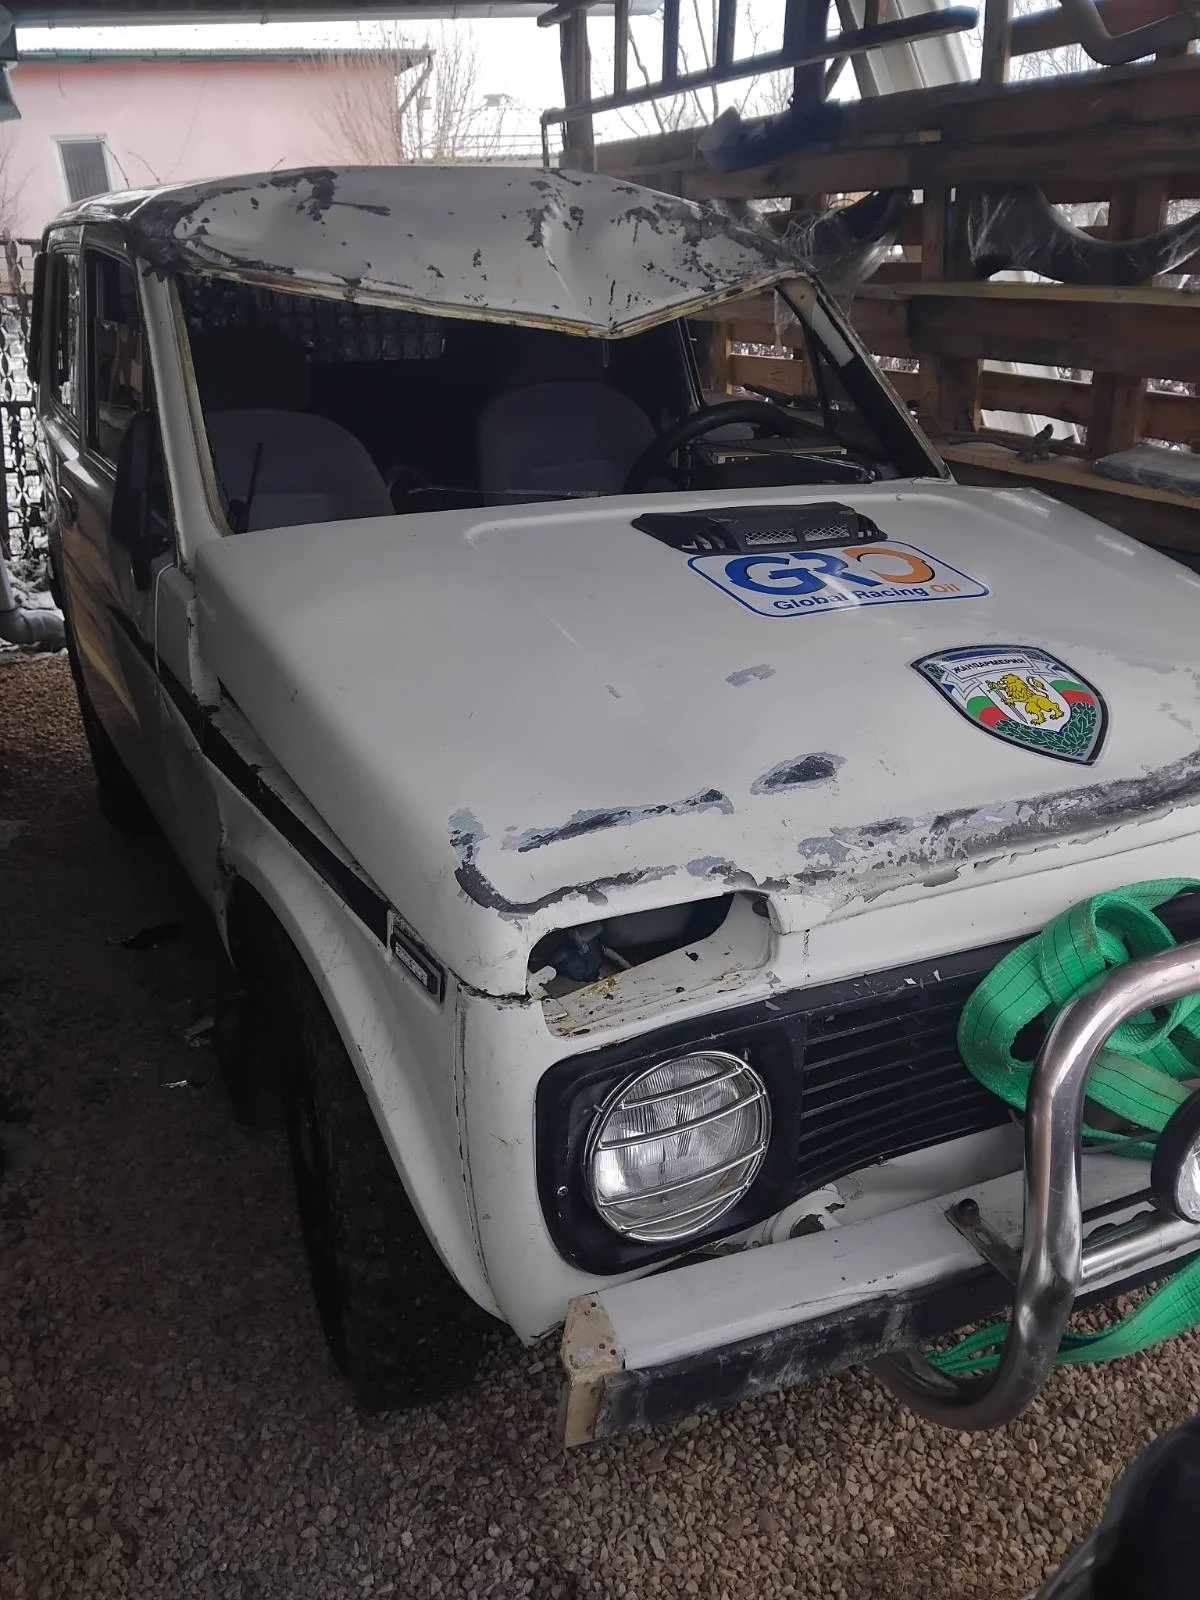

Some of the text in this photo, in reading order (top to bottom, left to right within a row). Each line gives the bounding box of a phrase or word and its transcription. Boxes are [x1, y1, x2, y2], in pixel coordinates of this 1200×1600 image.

[724, 547, 936, 596] GRO
[773, 583, 960, 611] Global Racing Oil
[952, 658, 1026, 674] ЖАНДАРМЕРИЯ
